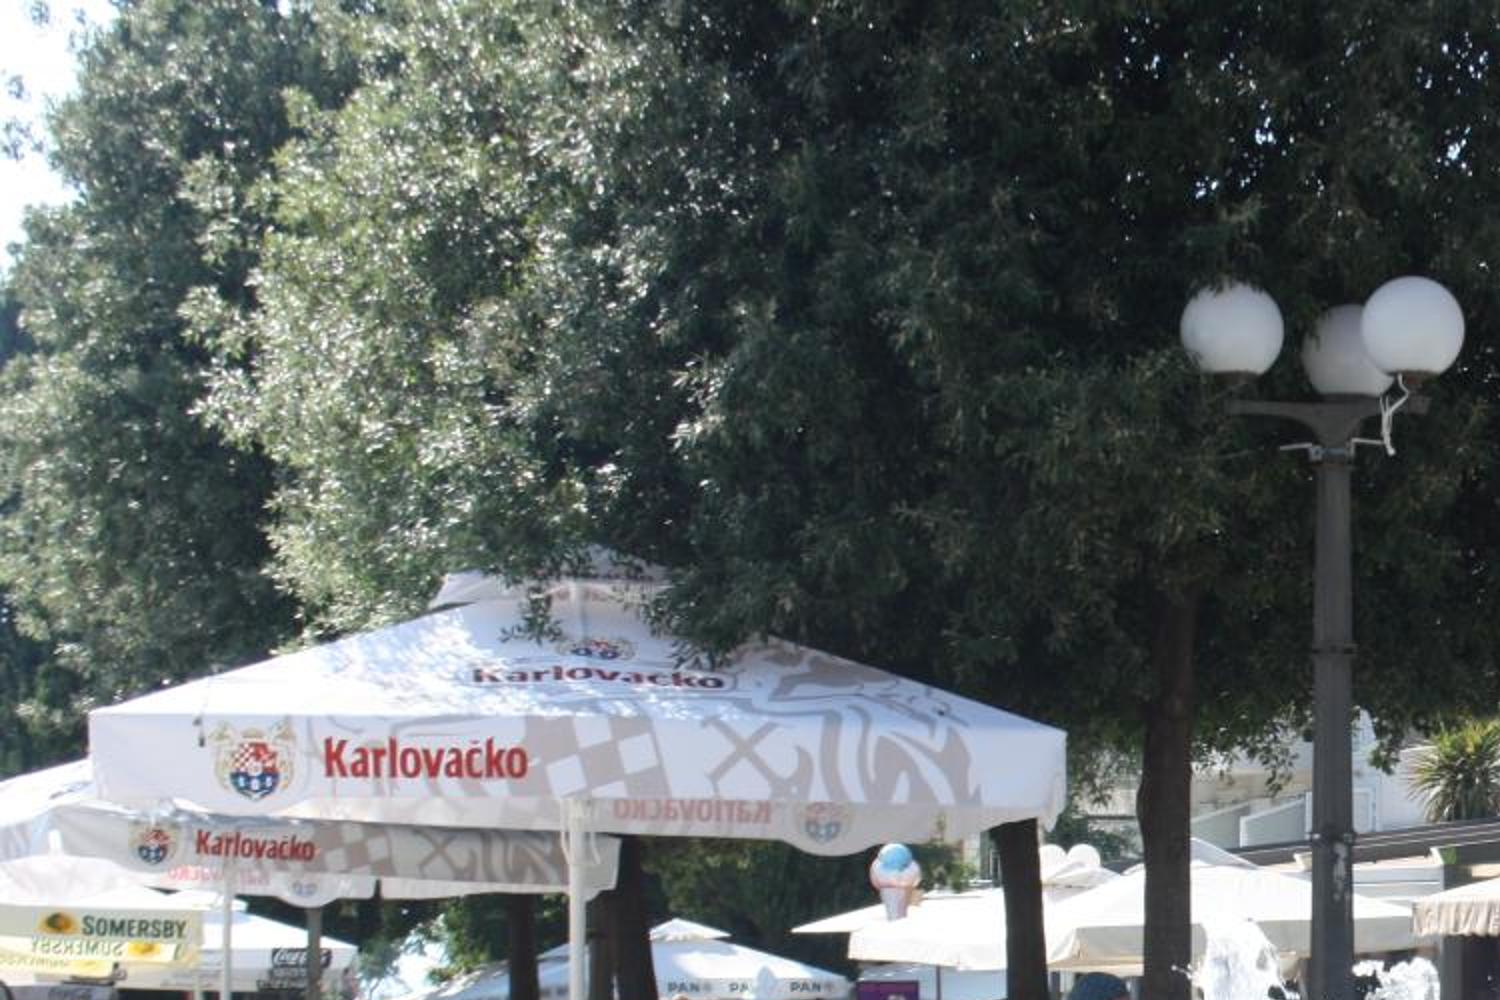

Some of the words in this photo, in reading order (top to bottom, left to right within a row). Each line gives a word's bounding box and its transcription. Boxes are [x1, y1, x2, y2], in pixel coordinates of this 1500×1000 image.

[324, 735, 529, 779] Karlovačko
[195, 828, 316, 862] Karlovačko
[82, 915, 188, 938] SOMERSBY
